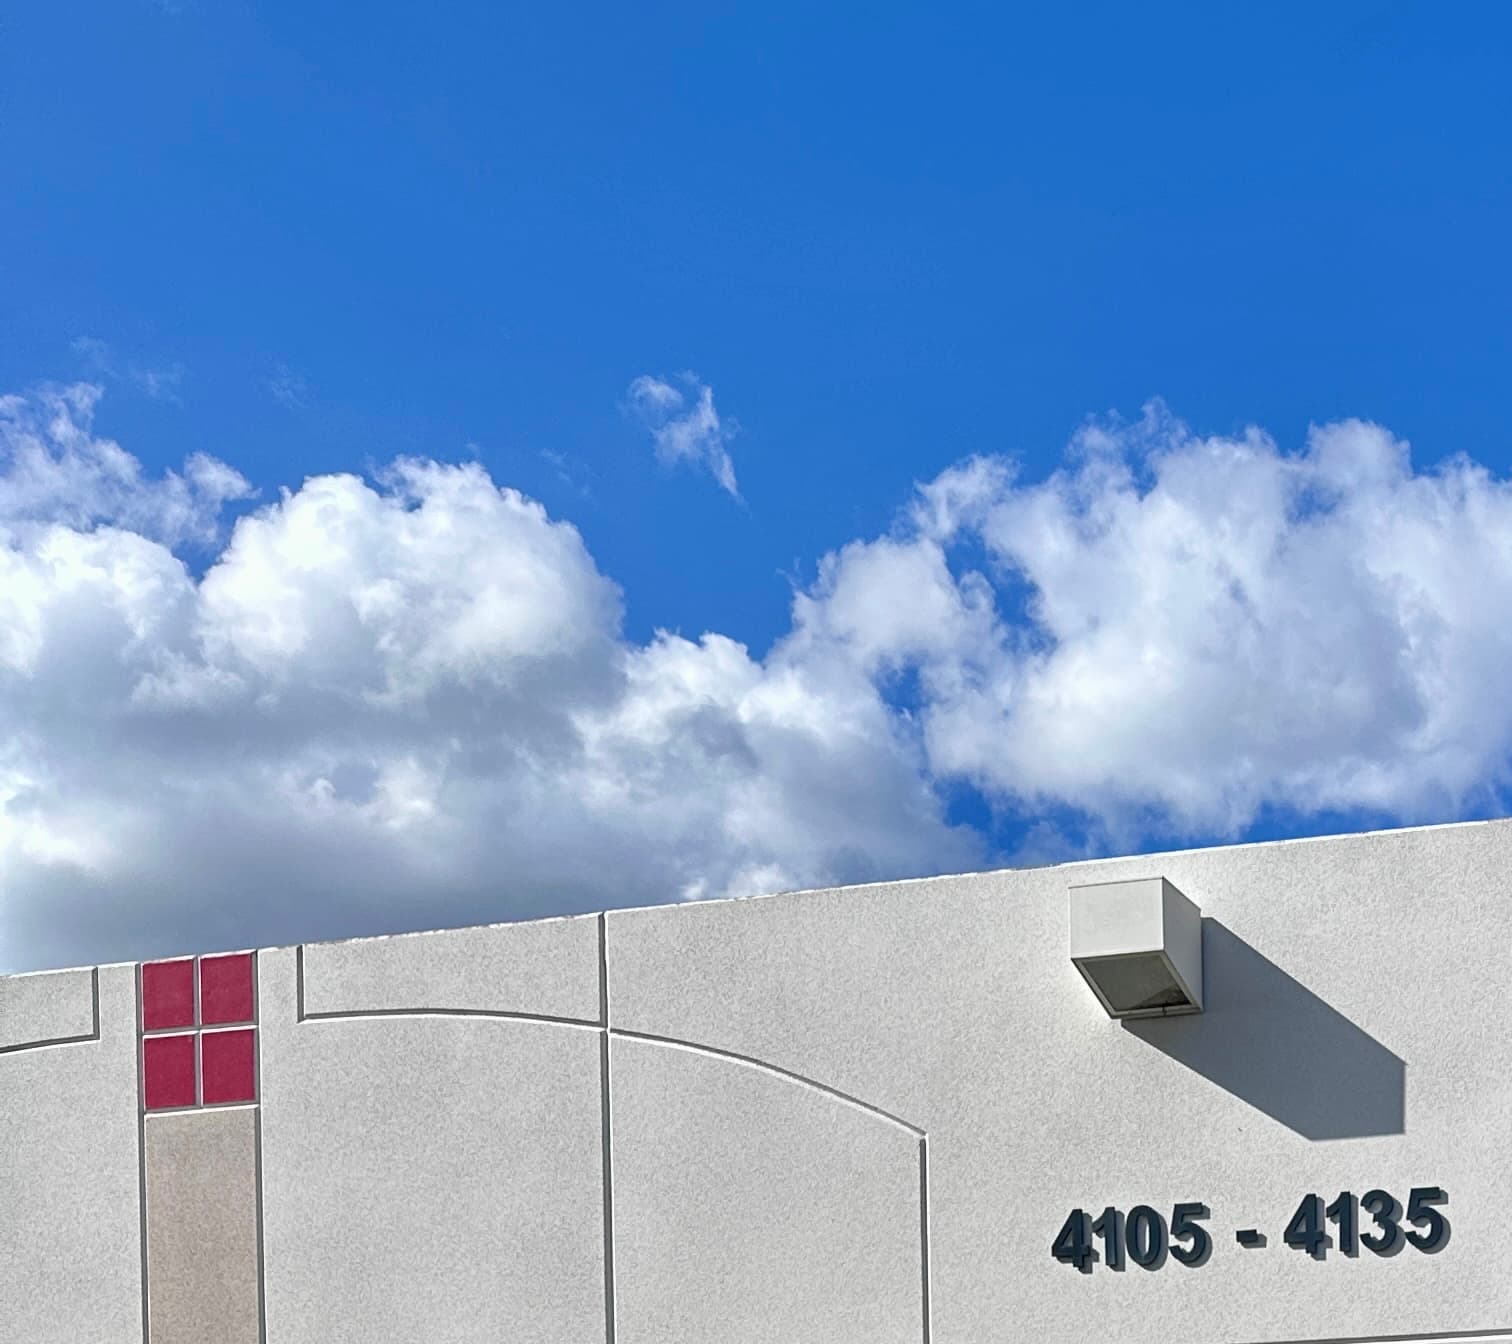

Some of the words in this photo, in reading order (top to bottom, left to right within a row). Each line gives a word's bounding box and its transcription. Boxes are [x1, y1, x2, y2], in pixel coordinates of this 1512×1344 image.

[1051, 1202, 1211, 1272] 4105
[1236, 1229, 1264, 1246] -
[1284, 1187, 1449, 1258] 4135
